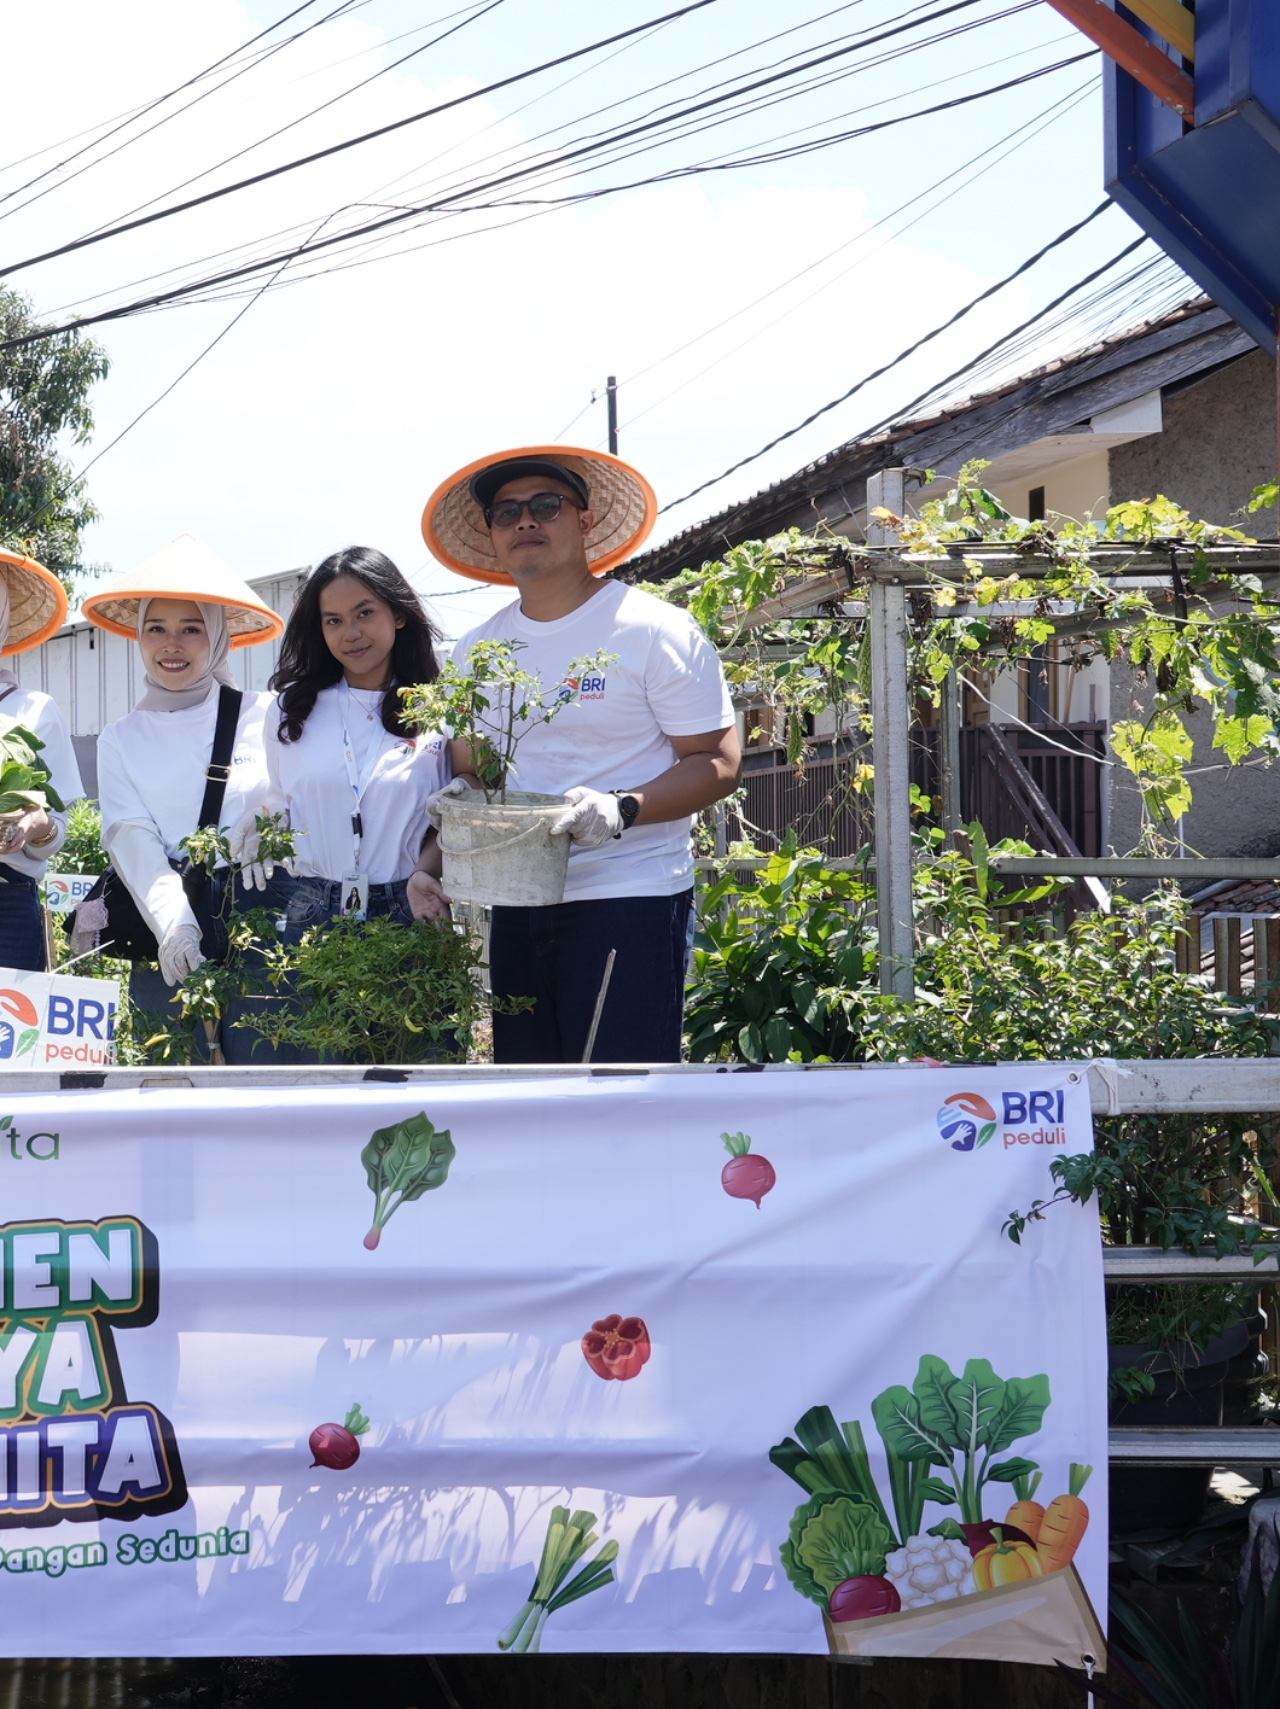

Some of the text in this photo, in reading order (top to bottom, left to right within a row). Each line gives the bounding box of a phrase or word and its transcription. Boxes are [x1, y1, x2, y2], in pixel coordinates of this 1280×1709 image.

[580, 692, 605, 701] peduli
[581, 678, 606, 692] BRI
[72, 881, 95, 896] BR
[47, 995, 116, 1041] BRI
[45, 1043, 114, 1066] peduli
[1001, 1089, 1065, 1125] BRI
[1003, 1127, 1066, 1150] peduli
[117, 1527, 250, 1567] Sedunia
